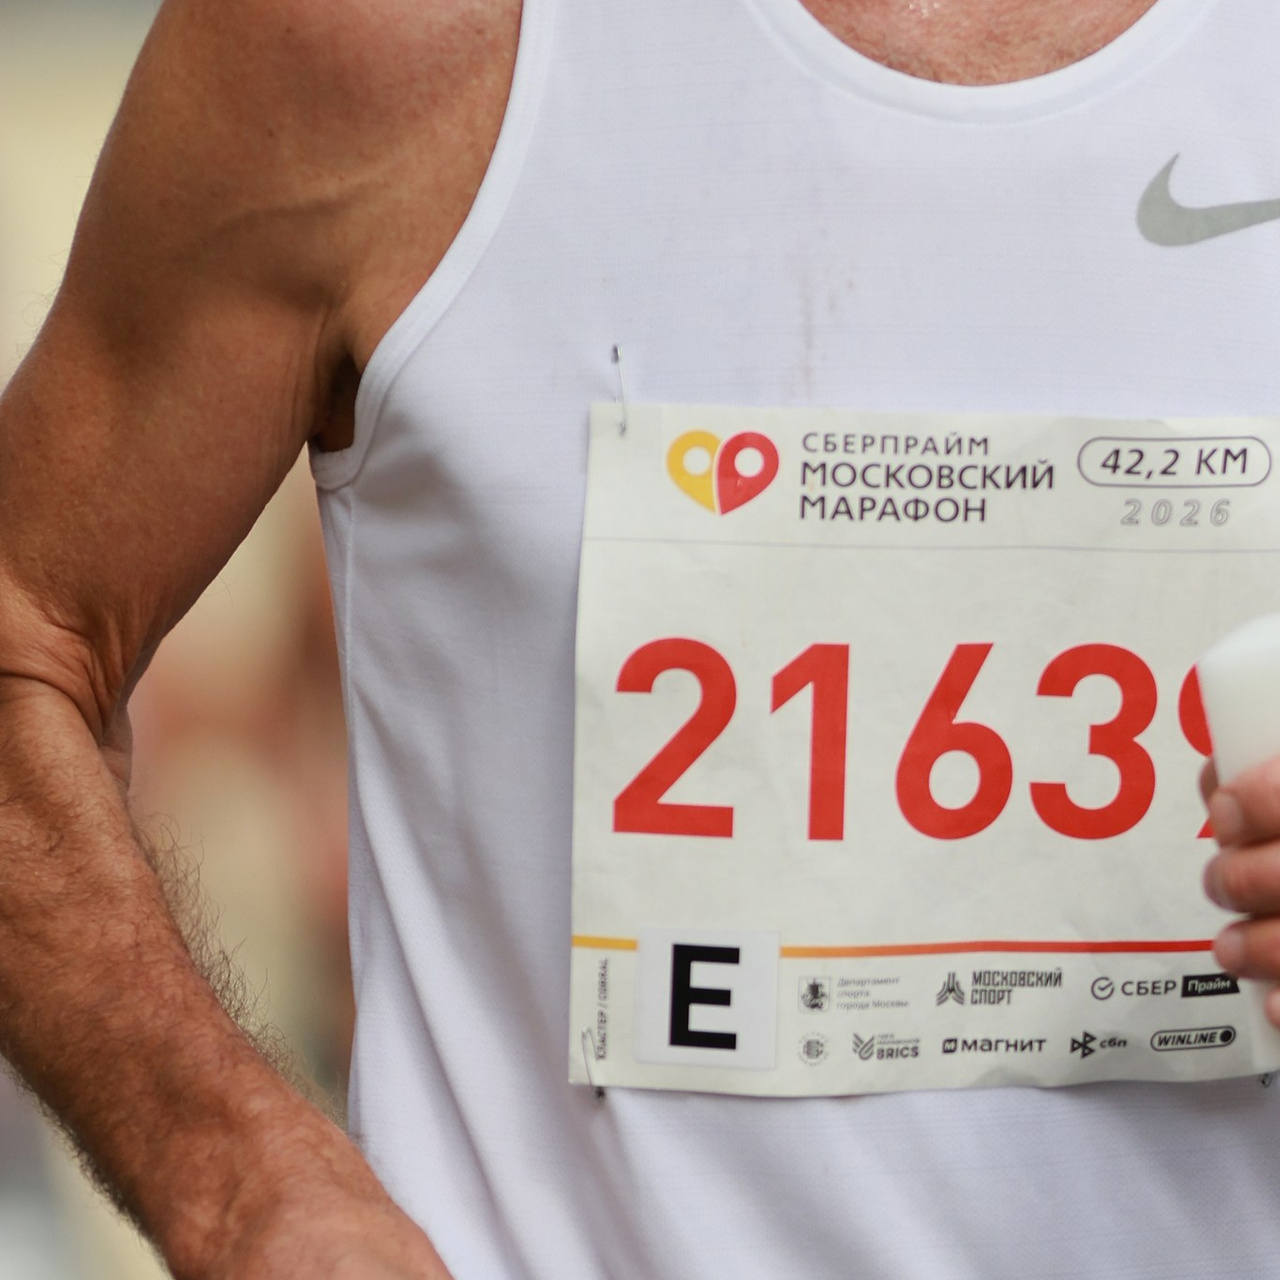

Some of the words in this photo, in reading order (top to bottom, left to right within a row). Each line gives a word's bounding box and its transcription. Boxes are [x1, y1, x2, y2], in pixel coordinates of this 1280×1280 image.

[802, 431, 989, 456] СБЕРПРАЙМ
[800, 458, 1055, 490] МОСКОВСКИЙ
[1100, 447, 1180, 480] 42,2
[1195, 447, 1248, 475] КМ
[799, 494, 987, 523] МАРАФОН
[1119, 497, 1231, 527] 2026
[971, 967, 1063, 988] МОСКОВСКИЙ
[1121, 979, 1177, 996] СБЕР
[1187, 977, 1232, 993] Прайм
[970, 988, 1013, 1006] СПОРТ
[1157, 1031, 1218, 1047] WINLINE
[876, 1046, 919, 1060] BRICS
